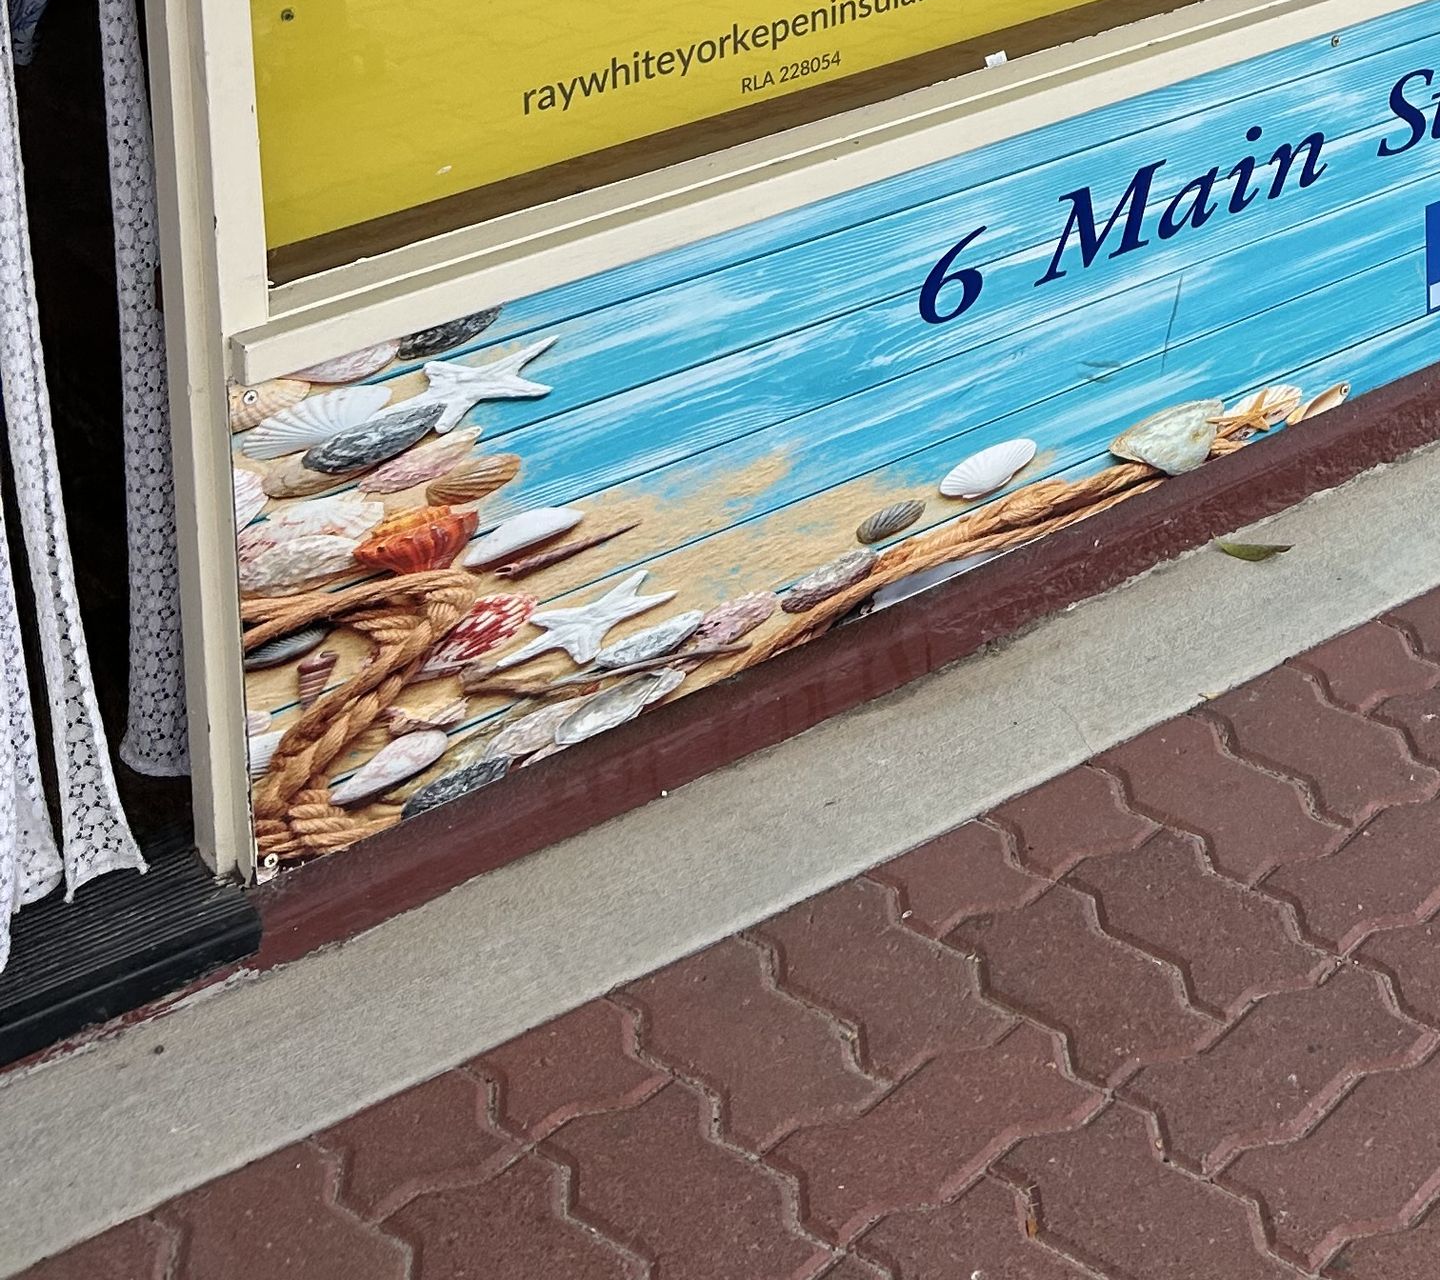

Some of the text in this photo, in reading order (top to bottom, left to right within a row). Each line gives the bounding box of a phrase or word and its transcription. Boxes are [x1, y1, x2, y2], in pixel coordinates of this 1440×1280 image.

[740, 51, 842, 95] RLA 228054
[917, 224, 986, 325] 6
[1034, 126, 1328, 287] Main
